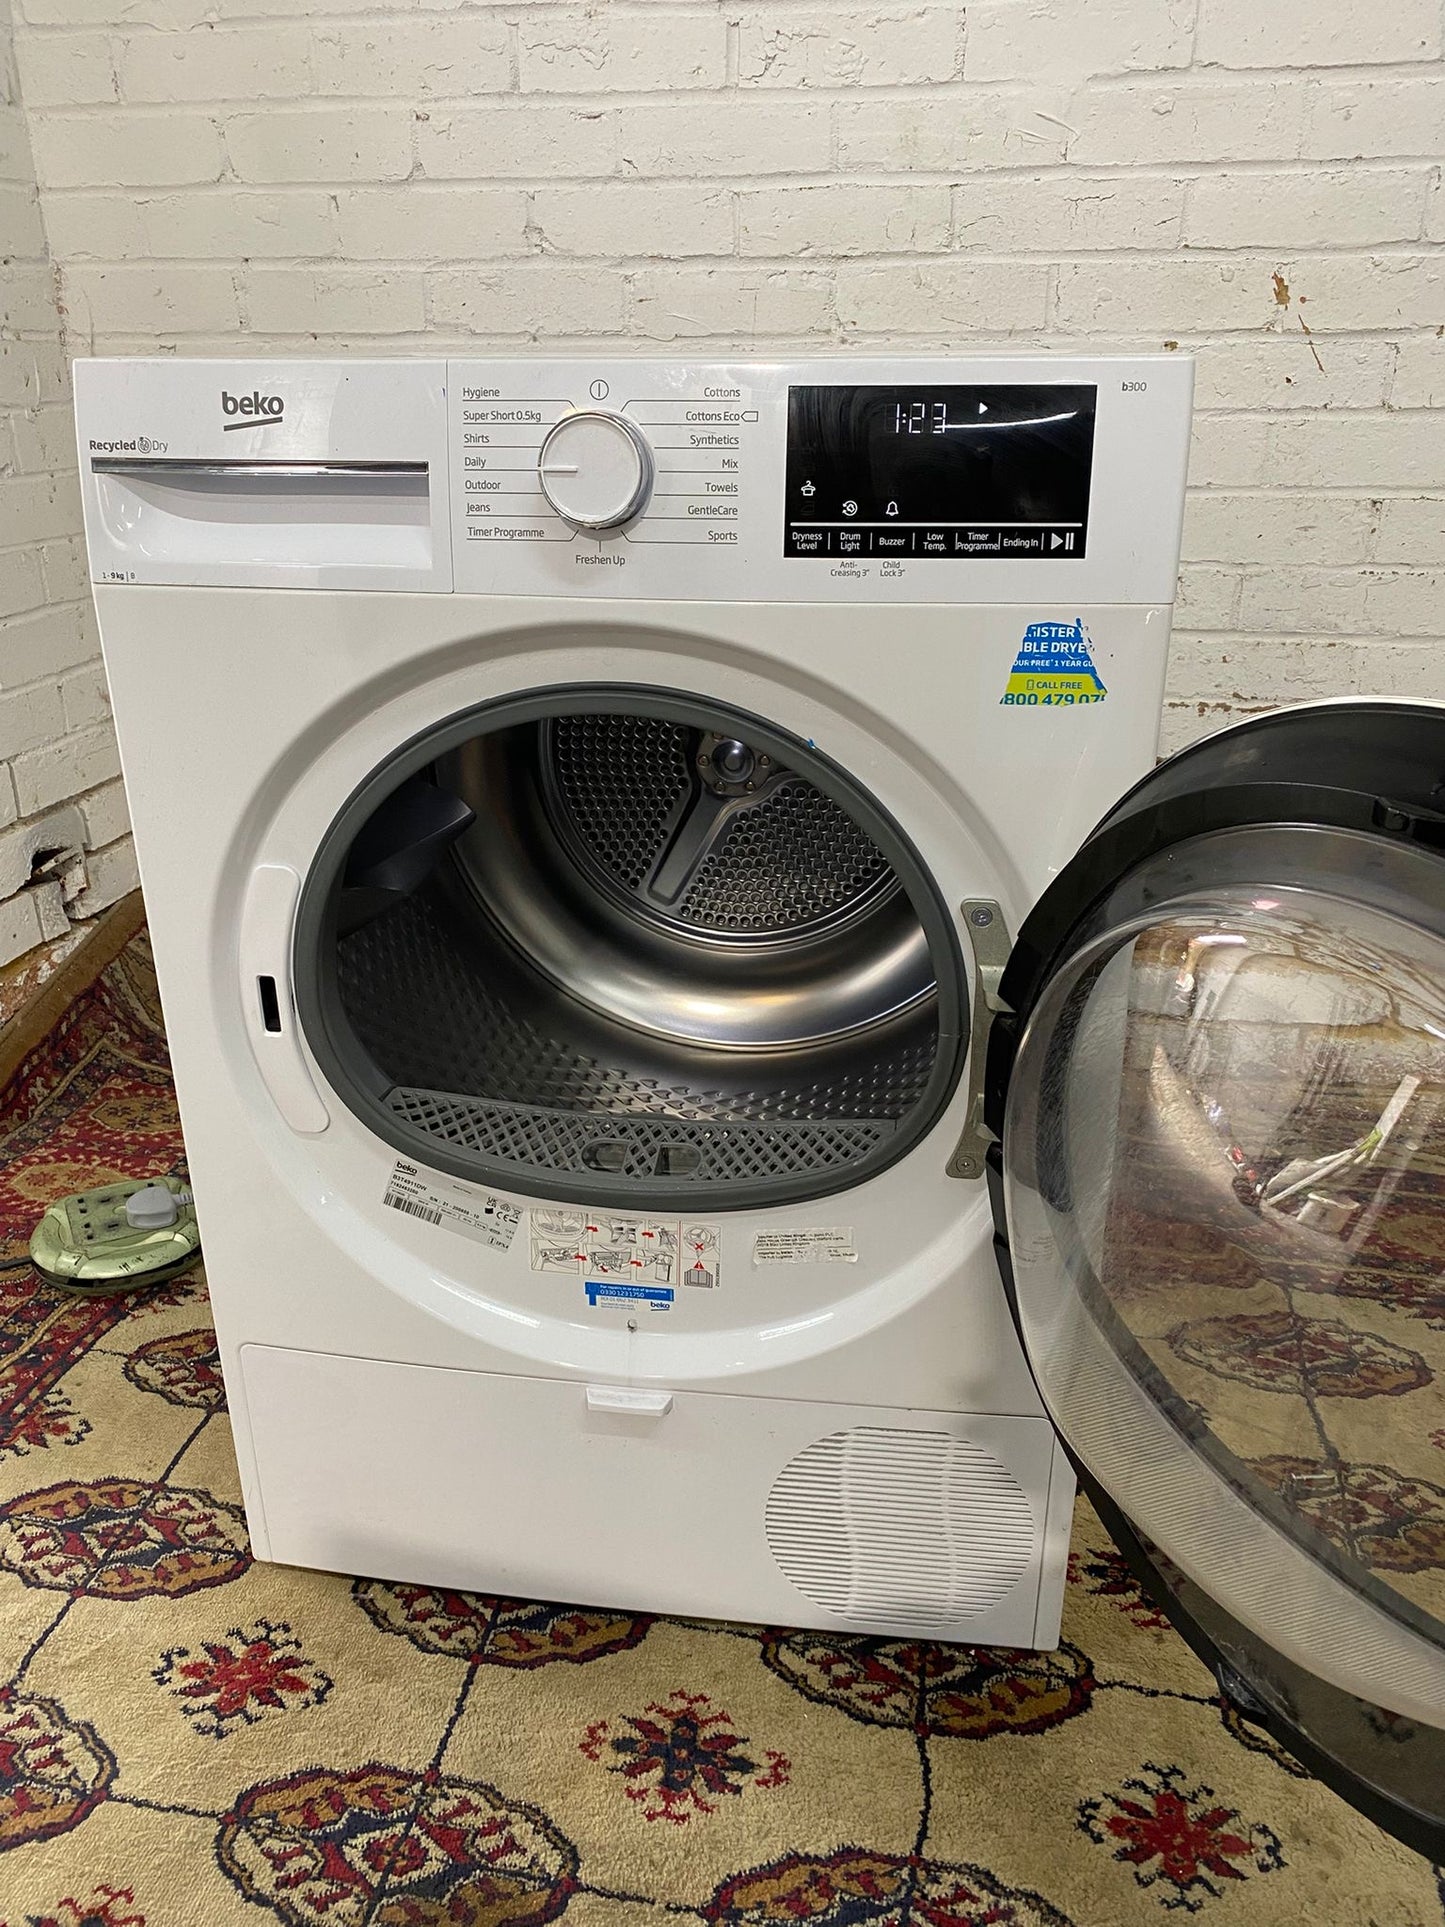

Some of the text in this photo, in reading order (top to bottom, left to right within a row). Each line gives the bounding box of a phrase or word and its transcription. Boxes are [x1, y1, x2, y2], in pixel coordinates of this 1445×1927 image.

[1121, 381, 1147, 392] b300
[462, 387, 500, 399] Hygiene
[703, 387, 741, 398] Cottons
[221, 391, 285, 416] beko
[463, 411, 542, 423] Super Short 0.5kg
[685, 411, 740, 421] Cottons Eco
[895, 402, 947, 434] 1:23
[463, 433, 490, 444] Shirts
[689, 434, 740, 446] Synthetics
[88, 439, 169, 453] Recycled Dry
[464, 456, 487, 469] Daily
[721, 459, 739, 469] Mix
[464, 480, 501, 490] Outdoor
[705, 482, 739, 493] Towels
[466, 502, 491, 513] Jeans
[687, 505, 738, 516] GentleCare
[467, 527, 545, 540] Timer Programme
[707, 530, 738, 542] Sports
[791, 531, 823, 542] Dryness
[840, 532, 861, 541] Drum
[926, 532, 944, 541] Low
[967, 531, 989, 541] Timer
[797, 541, 818, 550] Level
[840, 541, 860, 552] Light
[879, 537, 906, 546] Buzzer
[923, 541, 947, 552] Temp.
[957, 542, 998, 552] Programme
[1003, 538, 1039, 549] Ending In
[575, 555, 626, 566] Freshen Up
[839, 561, 858, 569] Anti-
[882, 561, 901, 569] Child
[830, 568, 861, 578] Creasing
[879, 568, 897, 577] Lock
[1020, 642, 1088, 653] BLE DRYE
[1036, 681, 1058, 689] CALL
[396, 1160, 418, 1174] beko
[650, 1300, 671, 1309] beko
